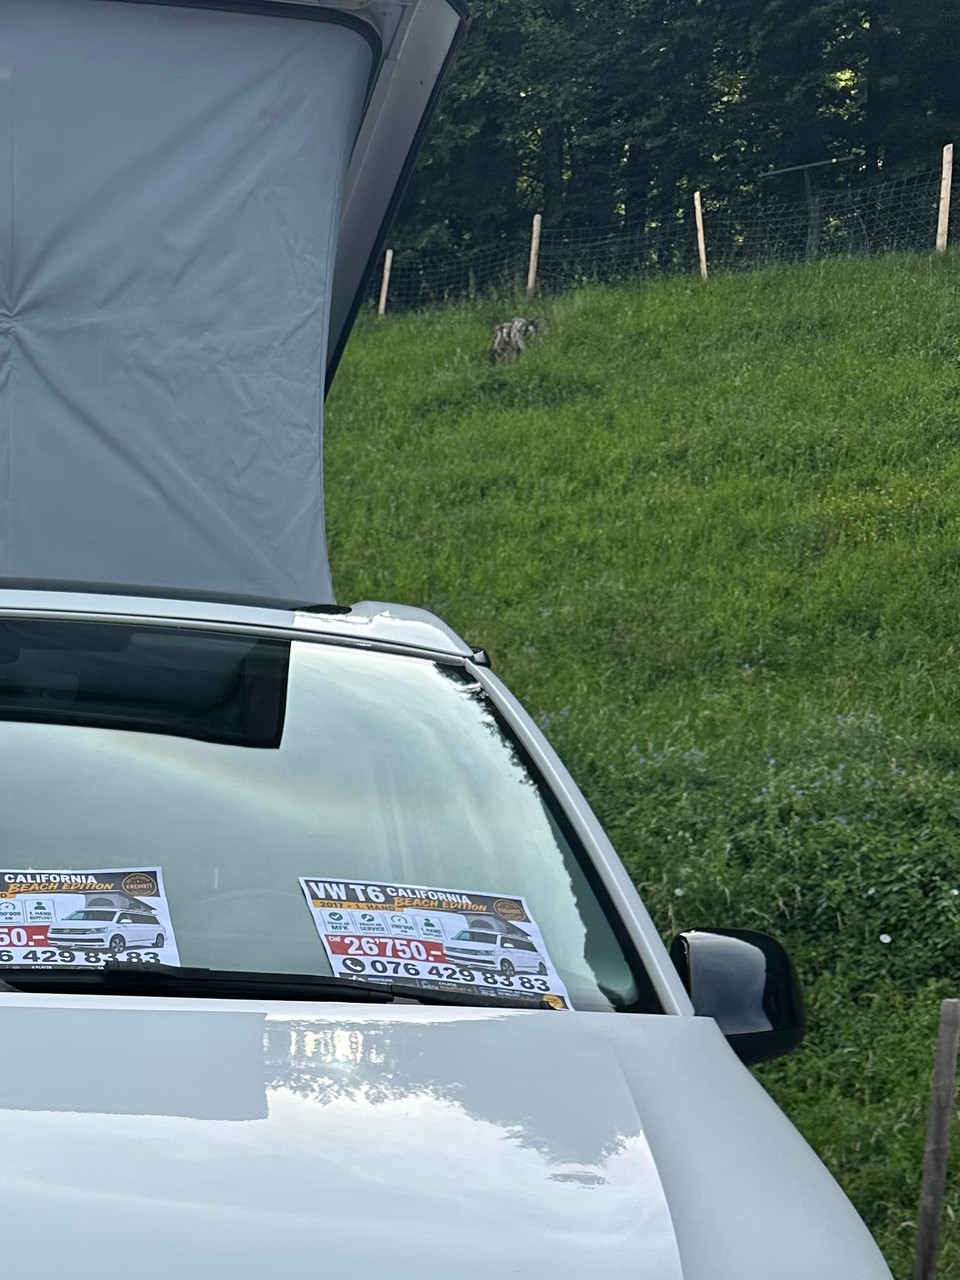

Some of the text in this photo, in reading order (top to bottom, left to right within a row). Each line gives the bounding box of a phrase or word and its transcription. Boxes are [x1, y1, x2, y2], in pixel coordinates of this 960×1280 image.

[4, 873, 97, 884] CALIFORNIA
[7, 882, 114, 894] BEACH EDITION
[309, 882, 385, 903] VW T6
[386, 887, 472, 905] CALIFORNIA
[366, 904, 395, 912] HAND
[393, 897, 437, 908] BEACH
[442, 900, 488, 912] EDITION
[344, 936, 442, 961] 26'750.-
[22, 950, 76, 963] 429
[84, 951, 118, 964] 83
[126, 951, 160, 963] 83
[370, 960, 551, 992] 076 429 83 83
